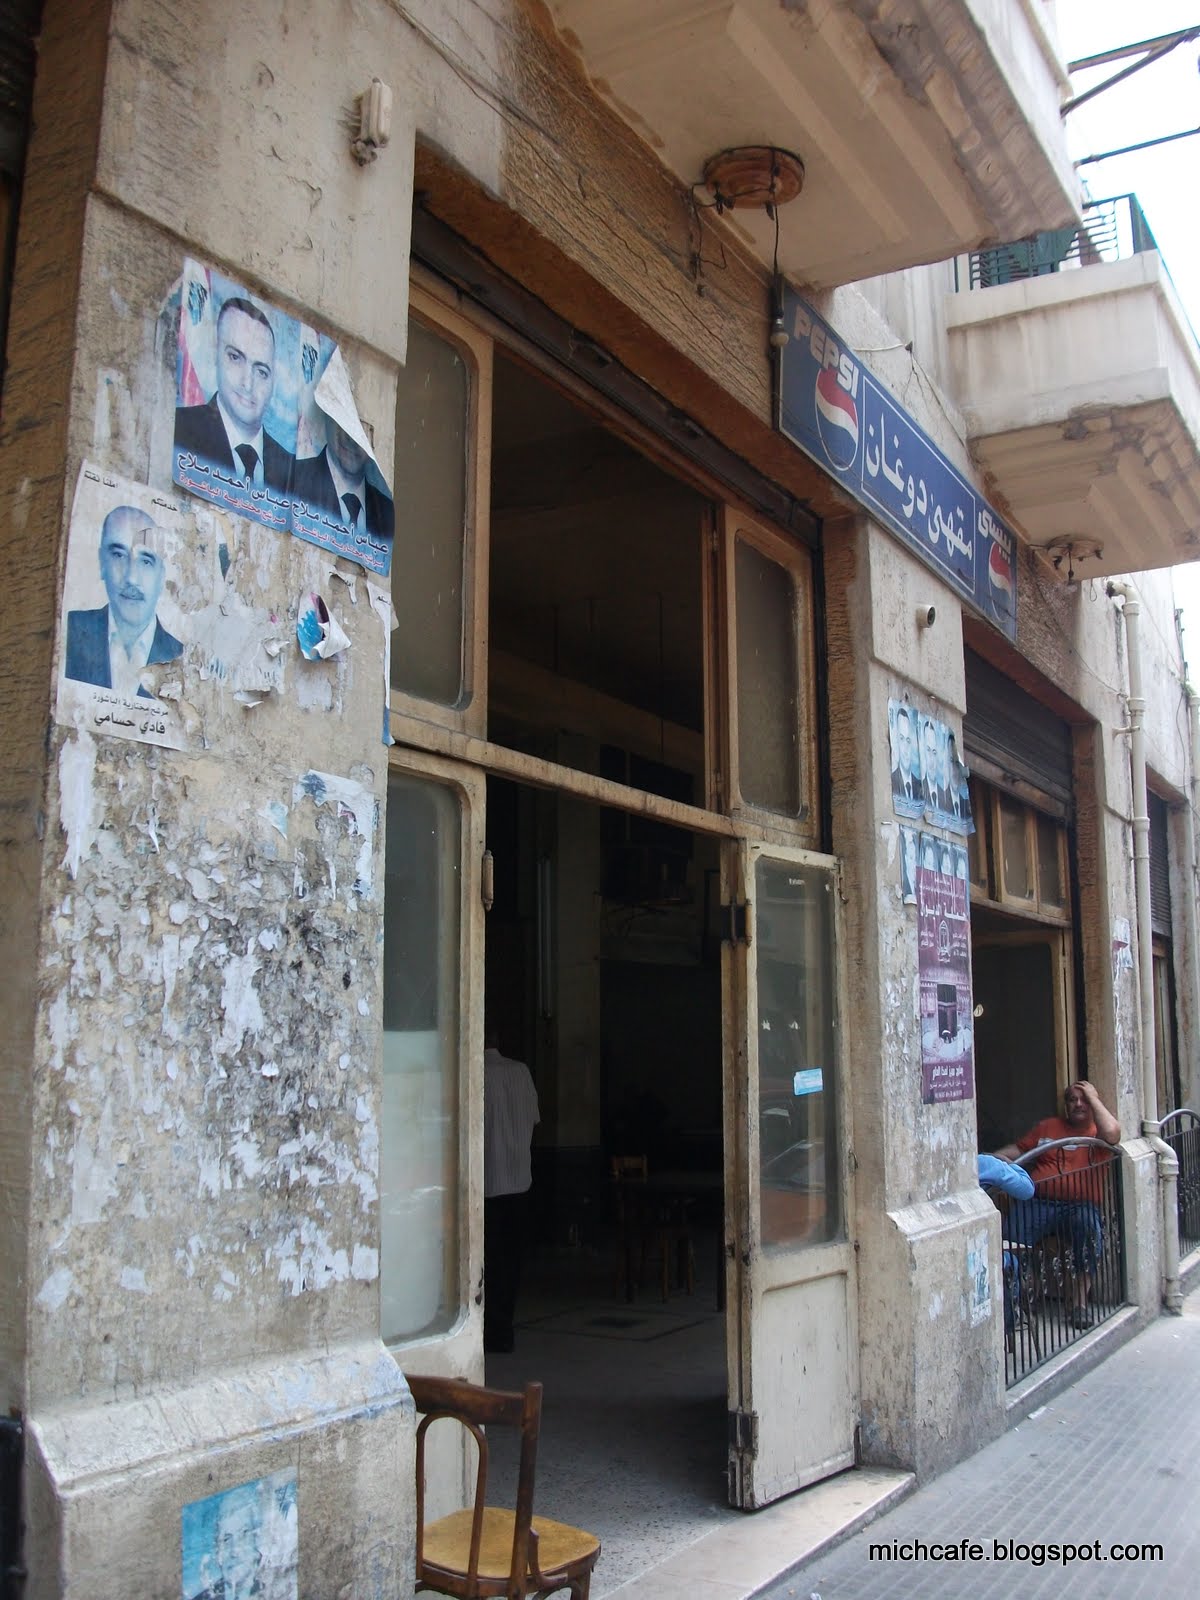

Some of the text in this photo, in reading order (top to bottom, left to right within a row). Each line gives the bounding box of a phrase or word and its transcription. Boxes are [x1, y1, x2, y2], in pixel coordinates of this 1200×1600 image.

[794, 304, 859, 399] PEPSI
[178, 452, 210, 473] ملاح
[866, 412, 928, 519] دوغان
[251, 488, 290, 509] عباس
[292, 501, 320, 518] ملاح
[355, 534, 389, 554] عباس
[94, 712, 166, 735] فادي حسامي
